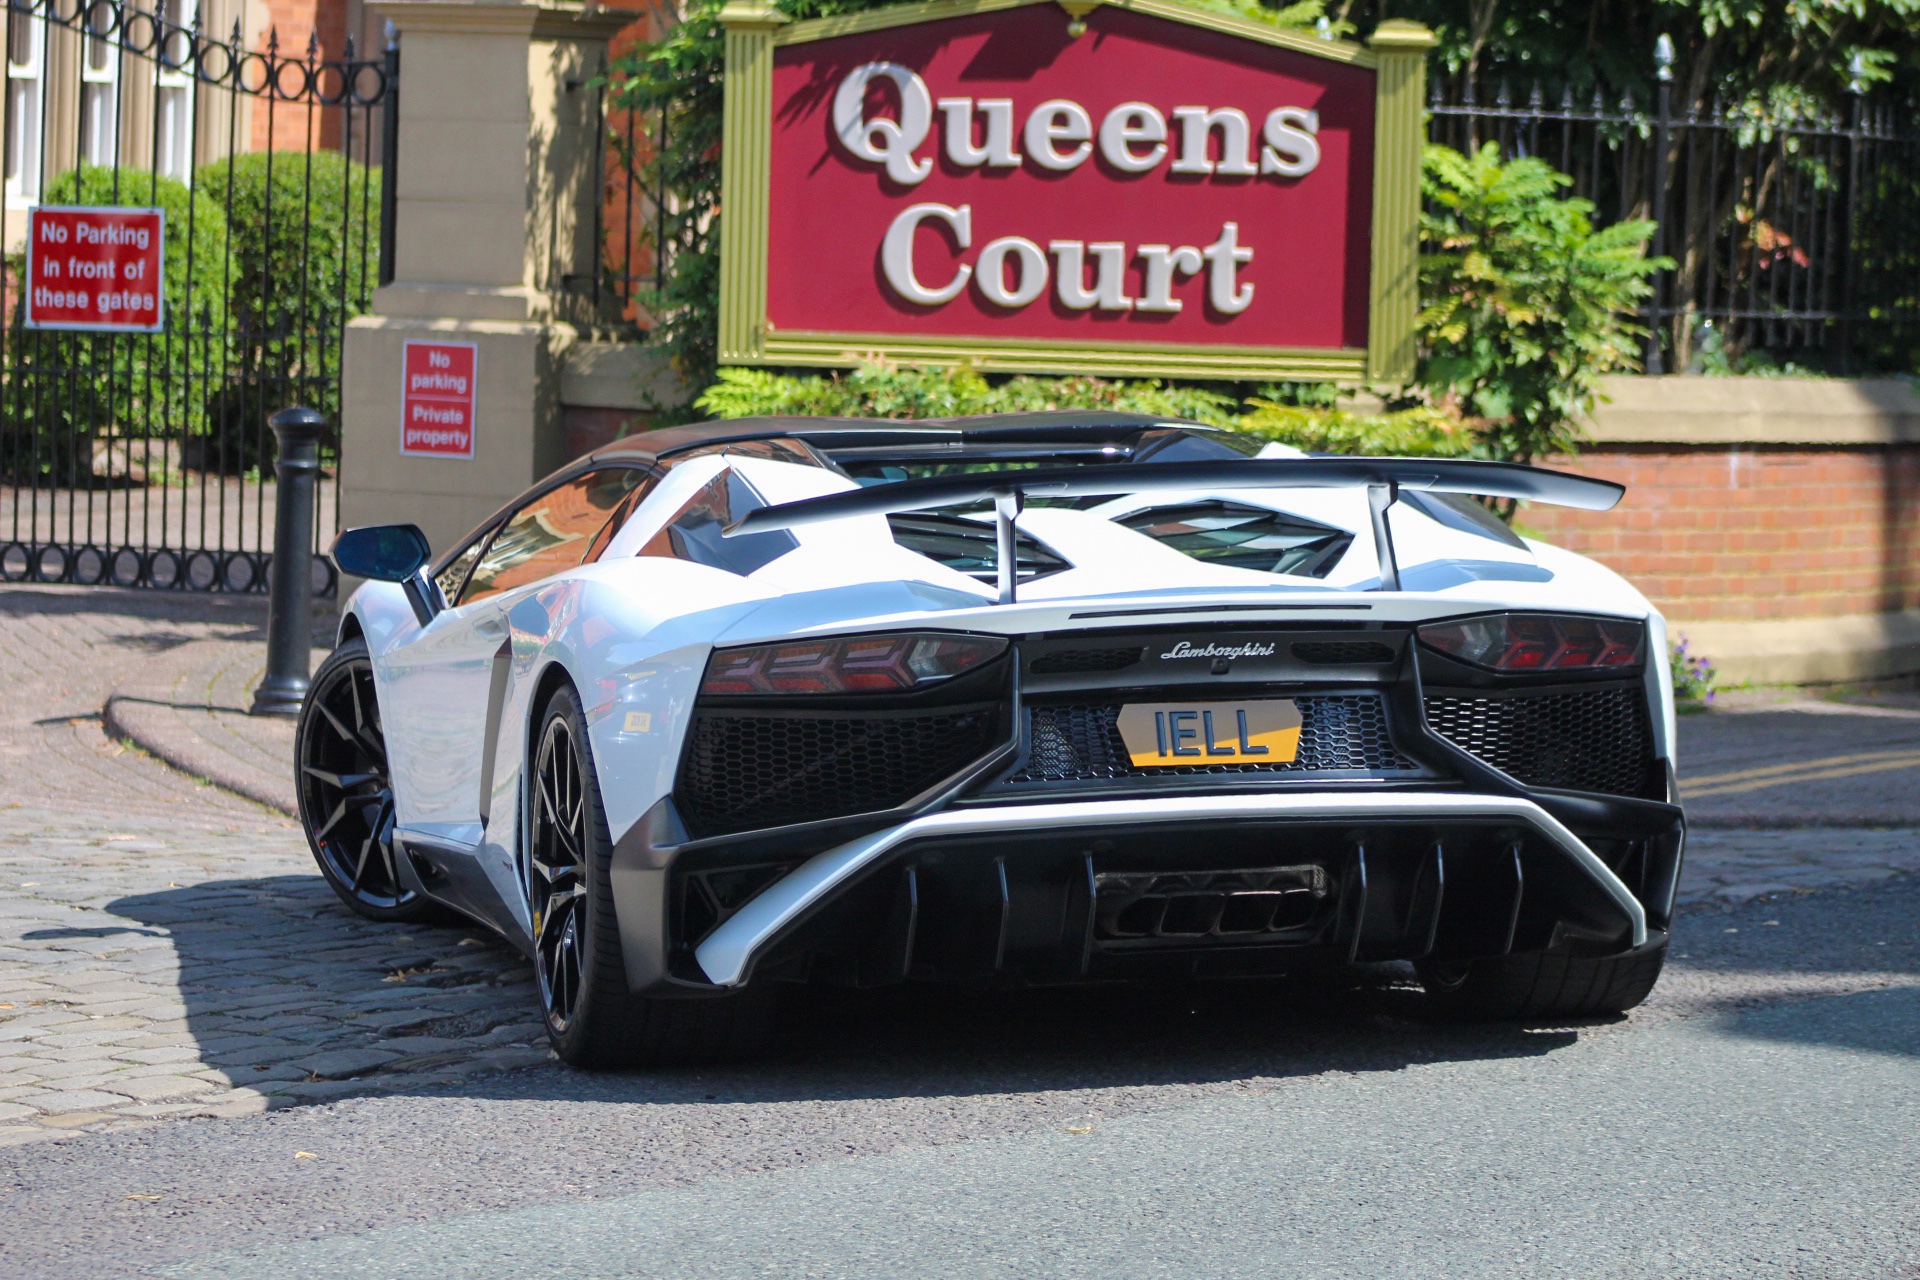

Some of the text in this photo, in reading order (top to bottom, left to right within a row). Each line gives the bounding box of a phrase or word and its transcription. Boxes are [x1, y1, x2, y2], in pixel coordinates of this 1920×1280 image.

[832, 61, 1321, 184] Queens
[41, 221, 149, 249] No Parking
[43, 256, 146, 280] in front of
[881, 202, 1255, 314] Court
[35, 287, 154, 313] these gates
[429, 351, 450, 368] No
[411, 374, 467, 394] parking
[413, 405, 464, 424] Private
[406, 429, 468, 449] property
[1161, 641, 1275, 660] Lamborghini
